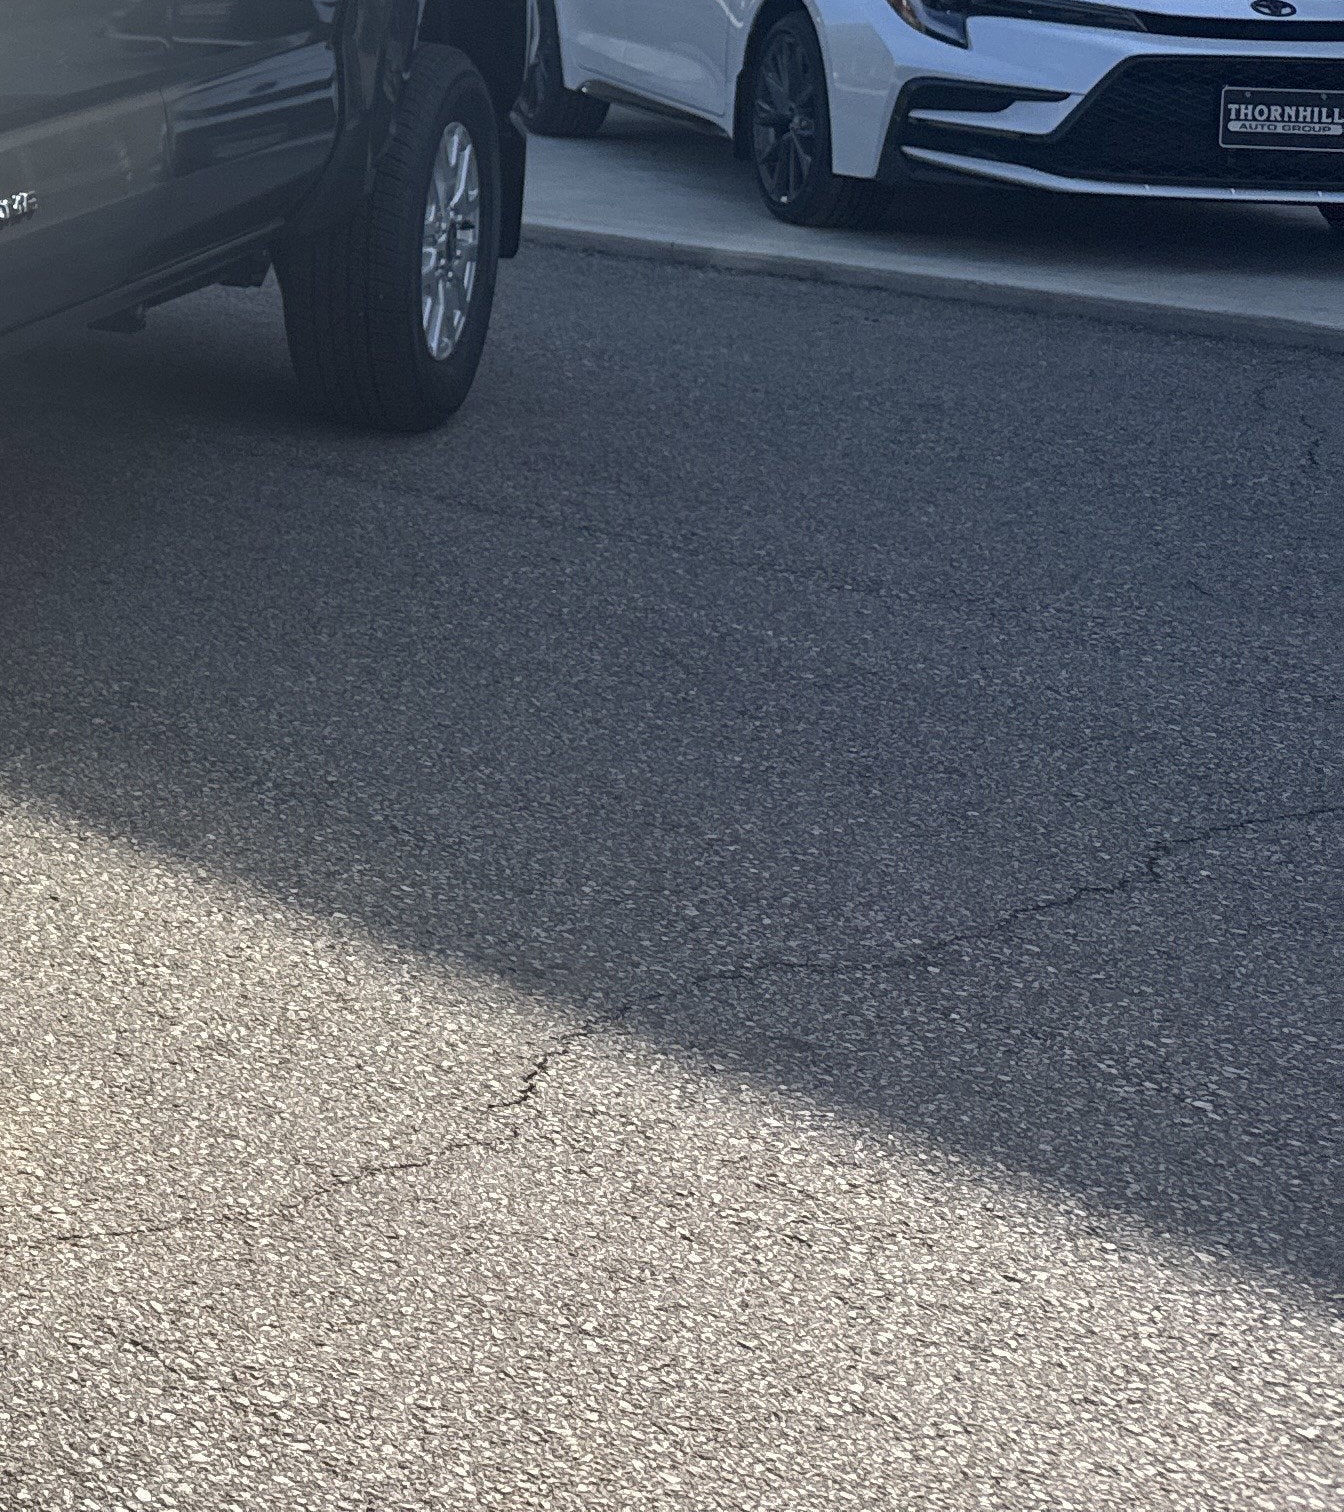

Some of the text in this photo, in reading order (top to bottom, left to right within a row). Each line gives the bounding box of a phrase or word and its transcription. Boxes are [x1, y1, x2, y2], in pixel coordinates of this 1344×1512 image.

[1227, 104, 1344, 123] THORNHILL
[1239, 123, 1332, 133] AUTO GROUP
